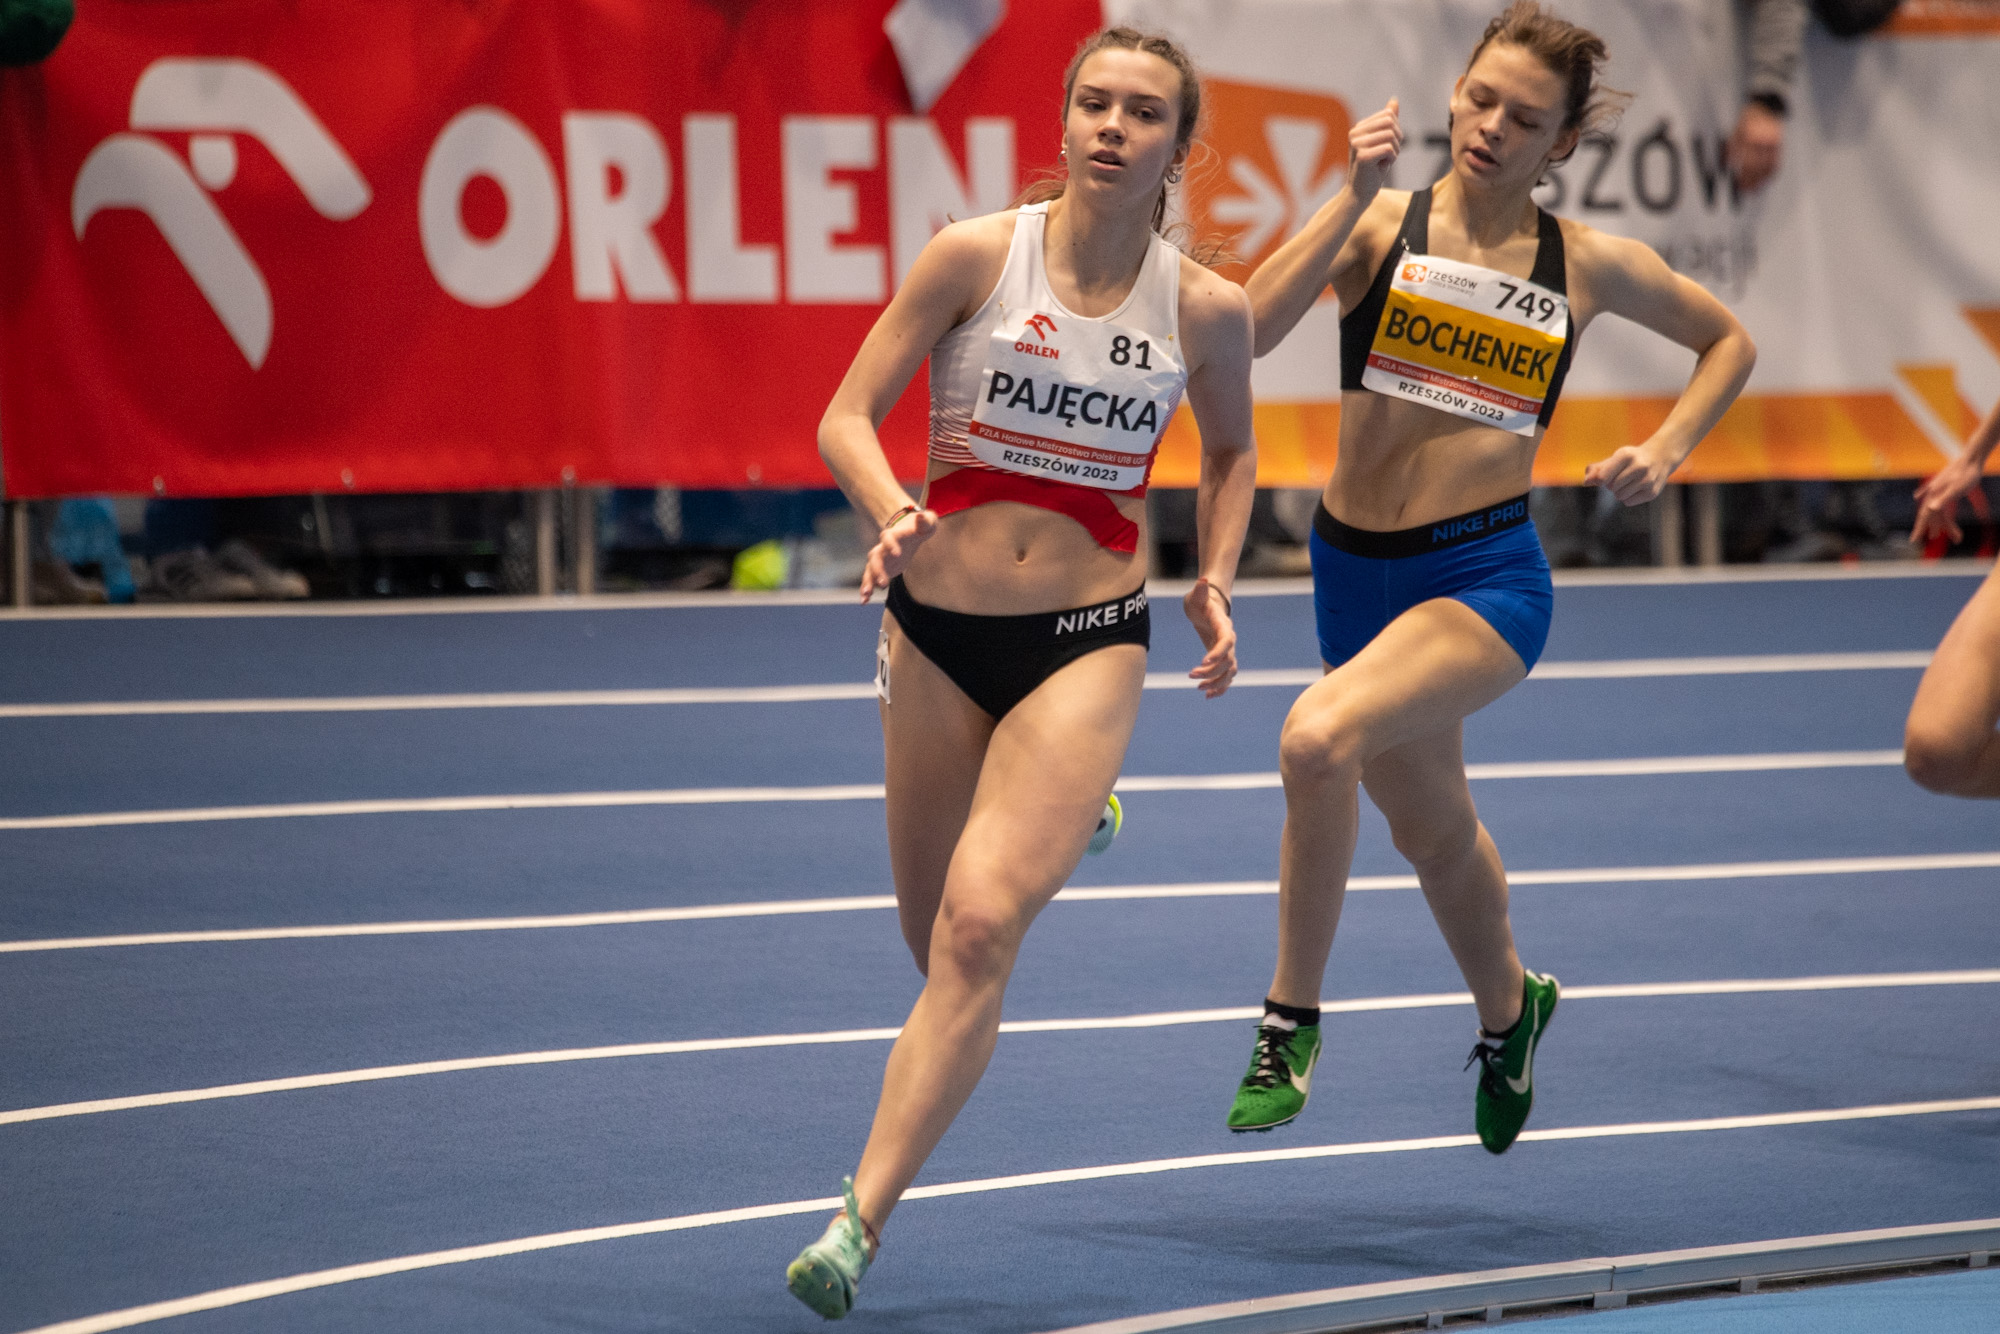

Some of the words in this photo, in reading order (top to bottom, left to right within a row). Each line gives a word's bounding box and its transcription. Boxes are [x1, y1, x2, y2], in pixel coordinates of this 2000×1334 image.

[418, 104, 1016, 309] ORLEN
[1495, 281, 1556, 323] 749
[1014, 341, 1060, 360] ORLEN
[1109, 335, 1152, 371] 81
[1385, 307, 1553, 383] BOCHENEK
[986, 370, 1157, 433] PAJĘCKA
[1377, 359, 1397, 371] PZLA
[1397, 364, 1429, 380] Halowe
[1429, 374, 1479, 395] Mistrzostwa
[1479, 389, 1503, 403] Polski
[1398, 381, 1468, 410] RZESZÓW
[1470, 402, 1505, 422] 2023
[978, 427, 999, 439] PZLA
[1001, 431, 1034, 447] Halowe
[1036, 440, 1090, 459] Mistrzostwa
[1090, 451, 1117, 463] Polski
[1118, 455, 1132, 464] U18
[1003, 450, 1080, 476] RZESZÓW
[1082, 466, 1119, 482] 2023
[1432, 515, 1484, 543] NIKE
[1488, 501, 1526, 527] PRO
[1055, 604, 1119, 635] NIKE
